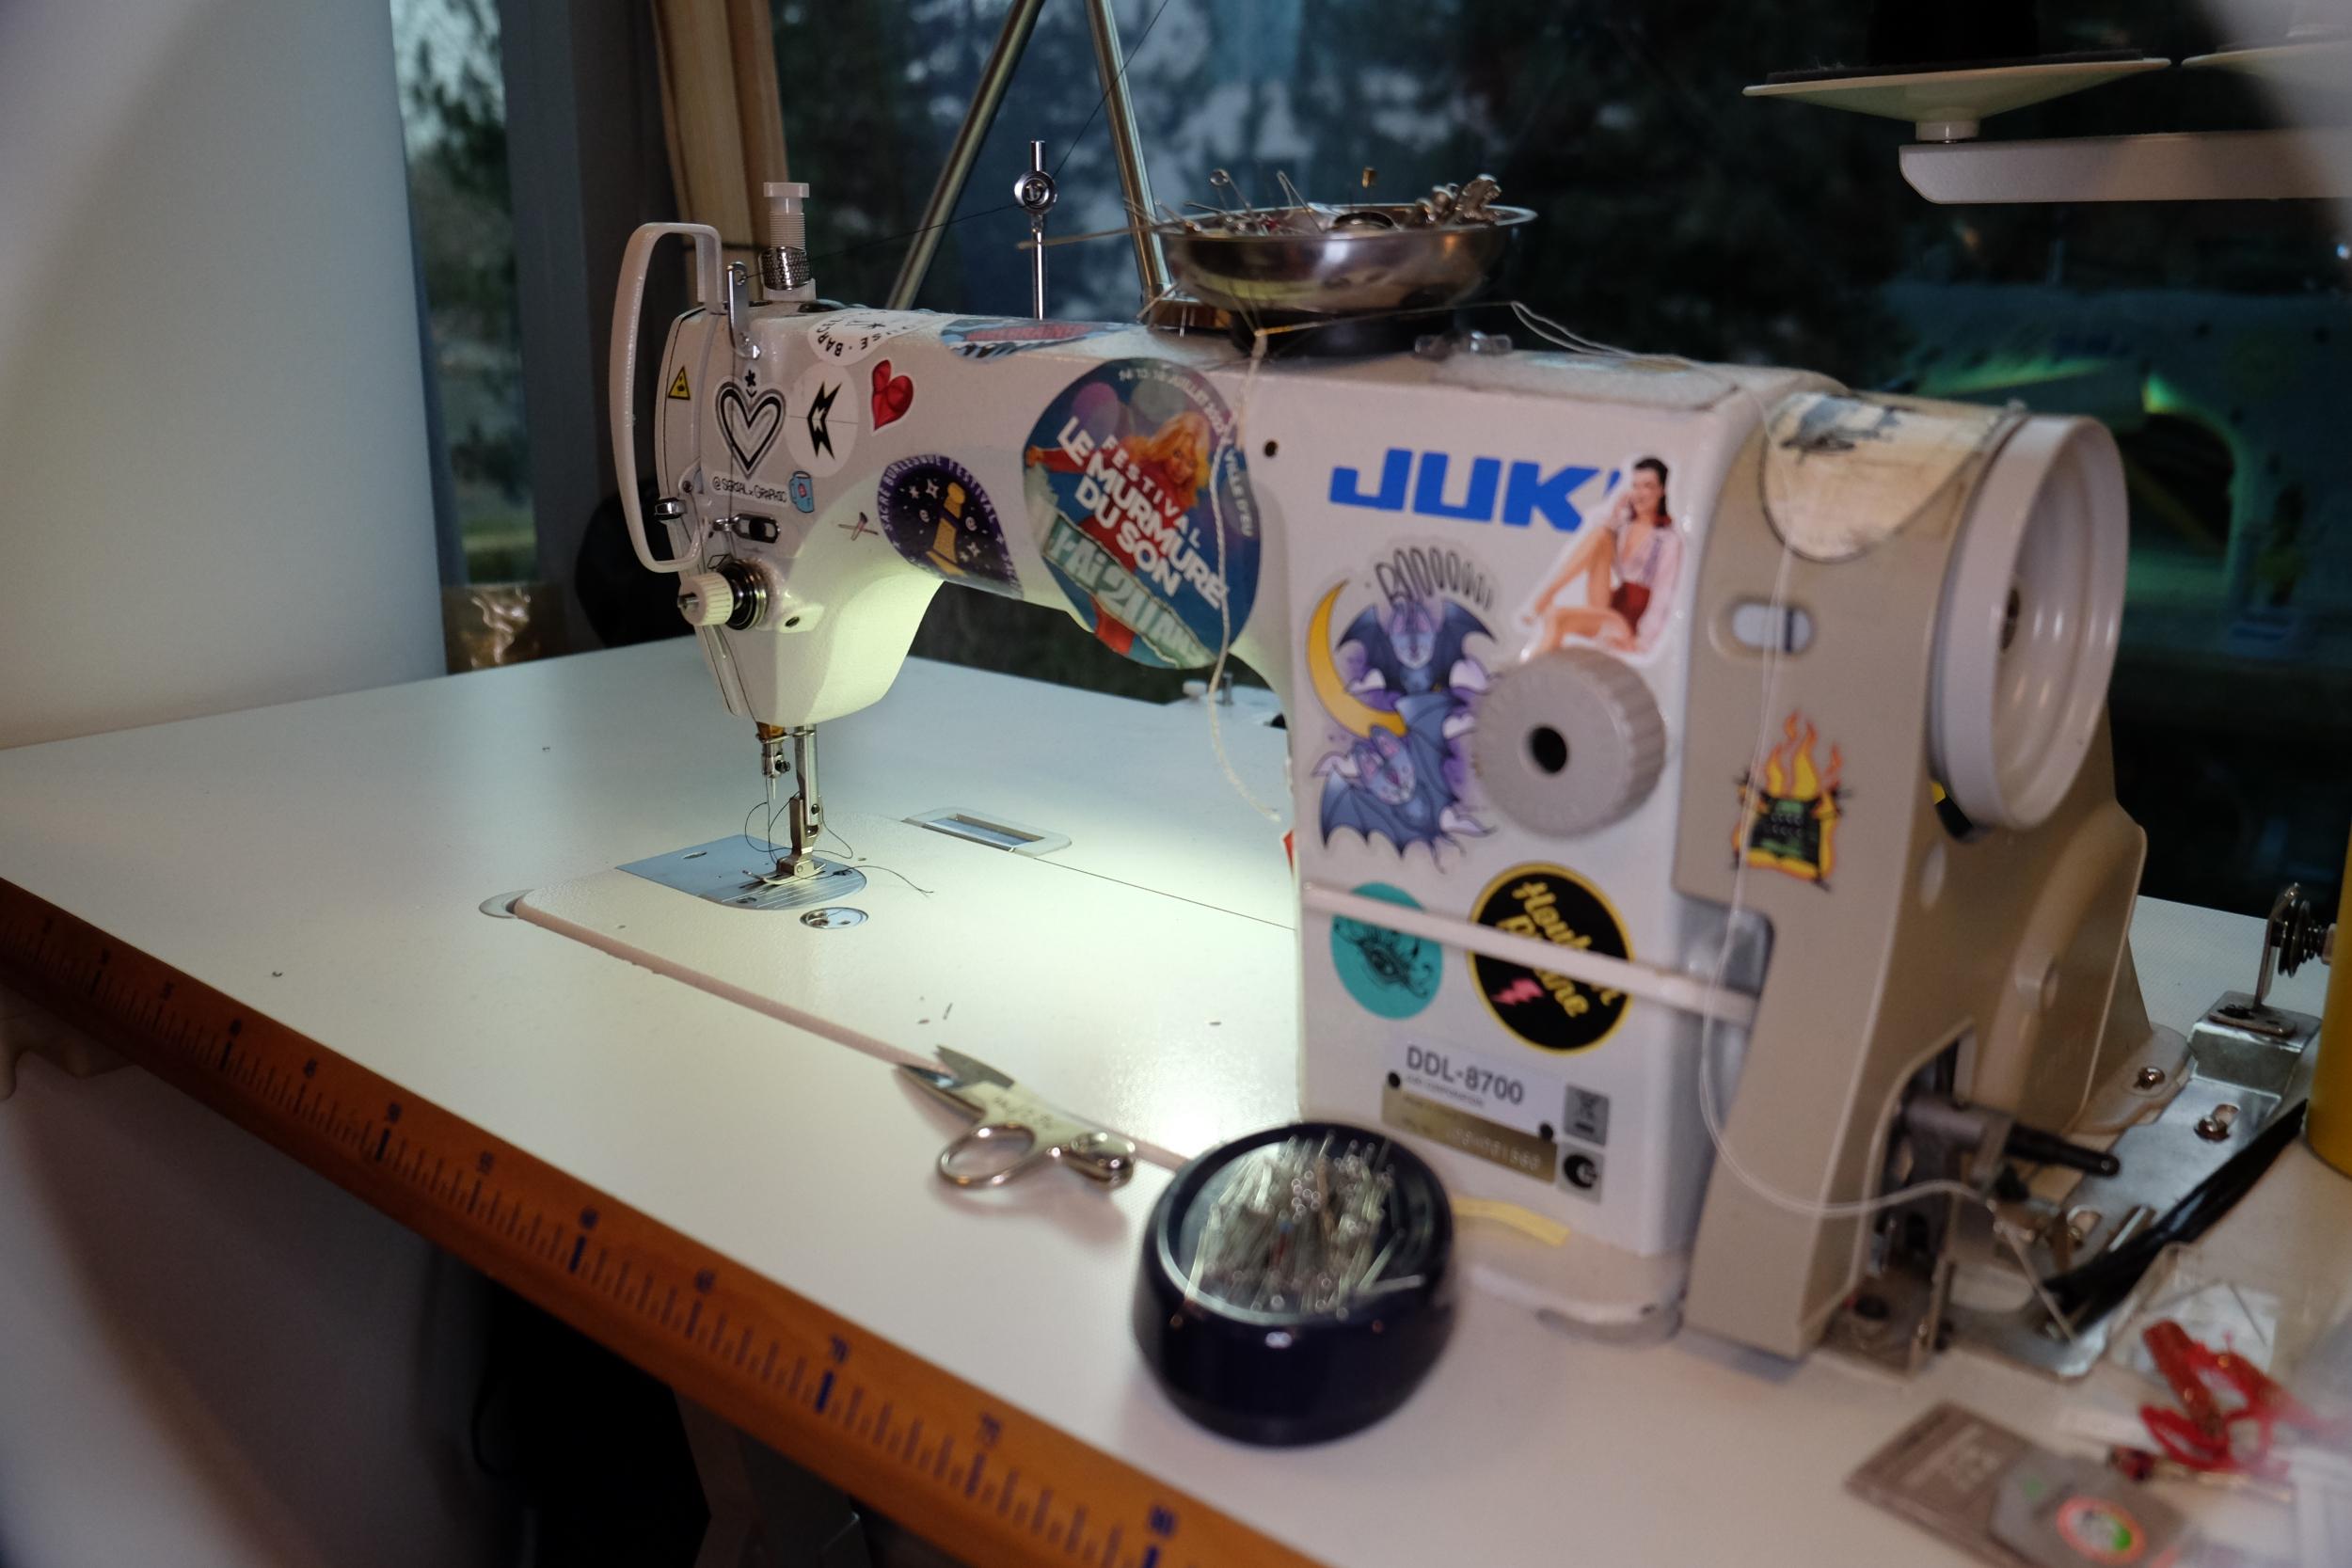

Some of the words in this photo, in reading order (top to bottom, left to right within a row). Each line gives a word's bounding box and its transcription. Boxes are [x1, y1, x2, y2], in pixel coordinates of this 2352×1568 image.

[947, 461, 997, 525] FESTIVAL
[1057, 416, 1095, 467] LE
[1085, 450, 1230, 610] MURMURE
[1074, 479, 1120, 530] DU
[1116, 520, 1182, 598] SON
[1102, 435, 1201, 548] FESTIVAL
[1328, 447, 1621, 533] JUK
[1406, 1045, 1525, 1106] DDL-8700
